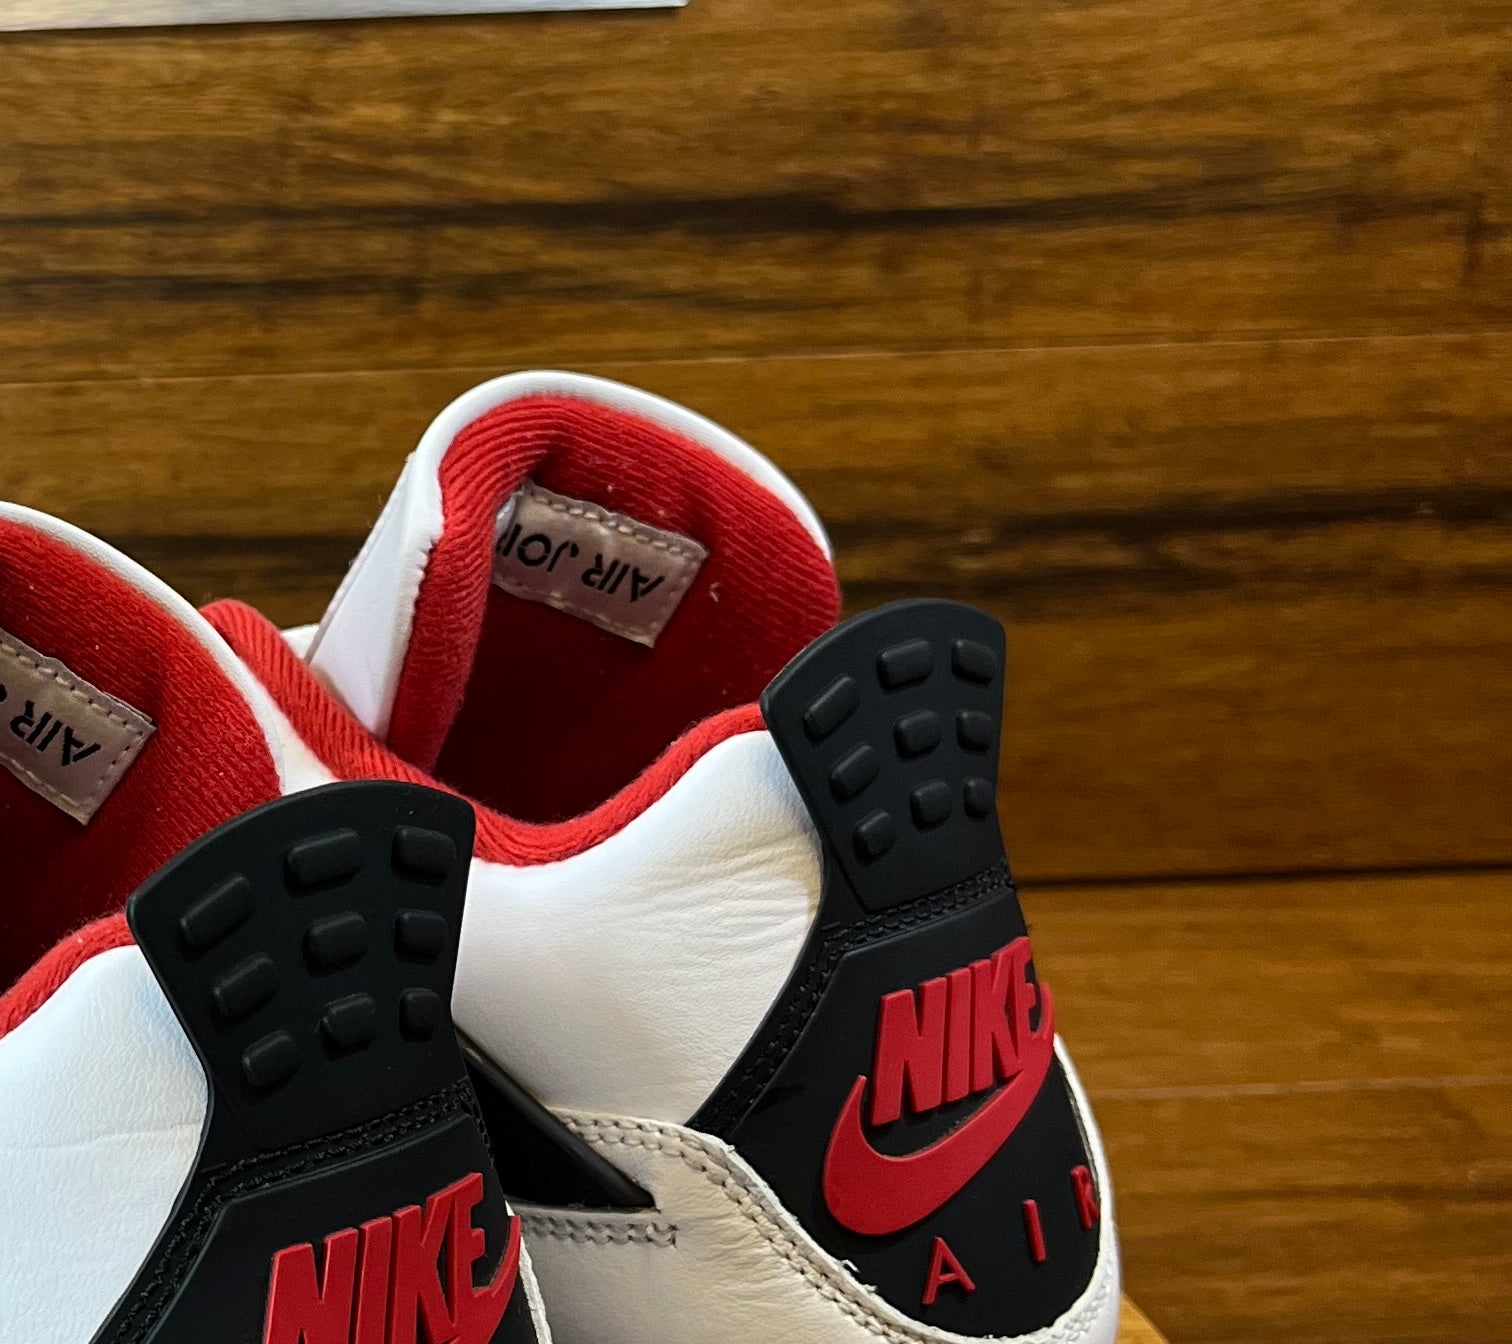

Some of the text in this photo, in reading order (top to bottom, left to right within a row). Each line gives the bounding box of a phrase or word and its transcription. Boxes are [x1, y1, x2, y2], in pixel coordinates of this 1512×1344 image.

[581, 553, 665, 603] AIR
[9, 700, 101, 766] AIR
[872, 936, 1037, 1127] NIKE
[921, 1165, 1100, 1305] AIR
